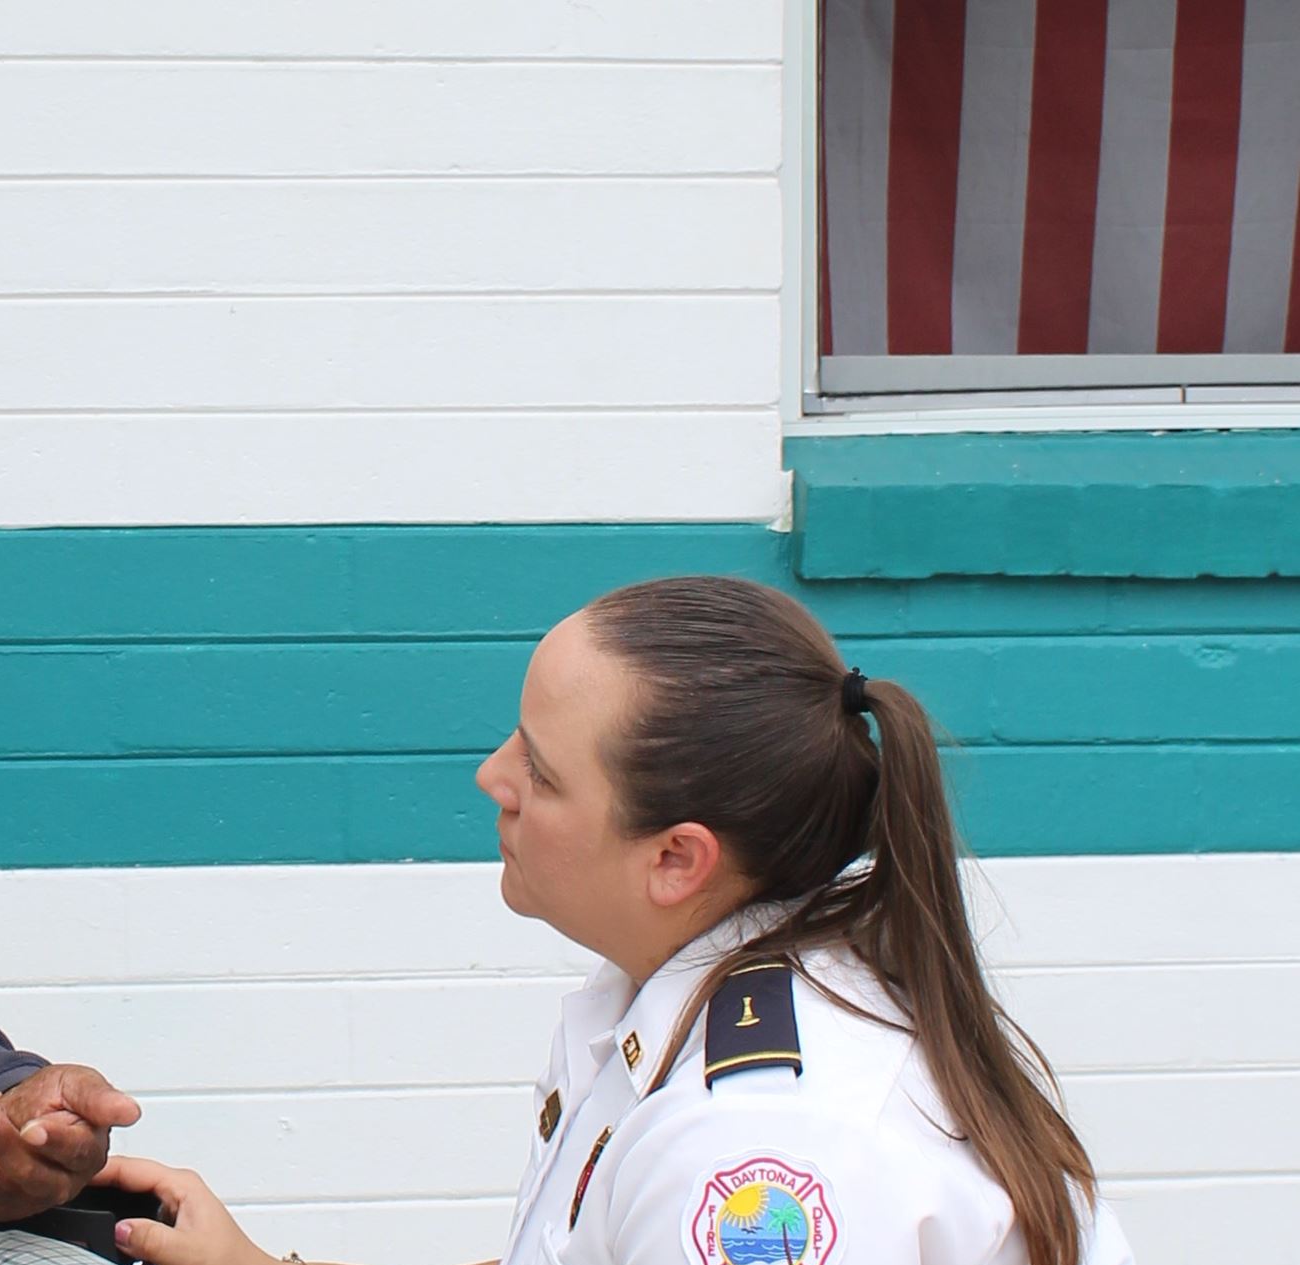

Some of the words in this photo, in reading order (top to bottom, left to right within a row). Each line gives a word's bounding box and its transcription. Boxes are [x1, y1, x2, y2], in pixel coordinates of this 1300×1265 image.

[731, 1169, 797, 1190] DAYTONA
[707, 1205, 716, 1257] FIRE
[812, 1207, 823, 1259] DEPT
